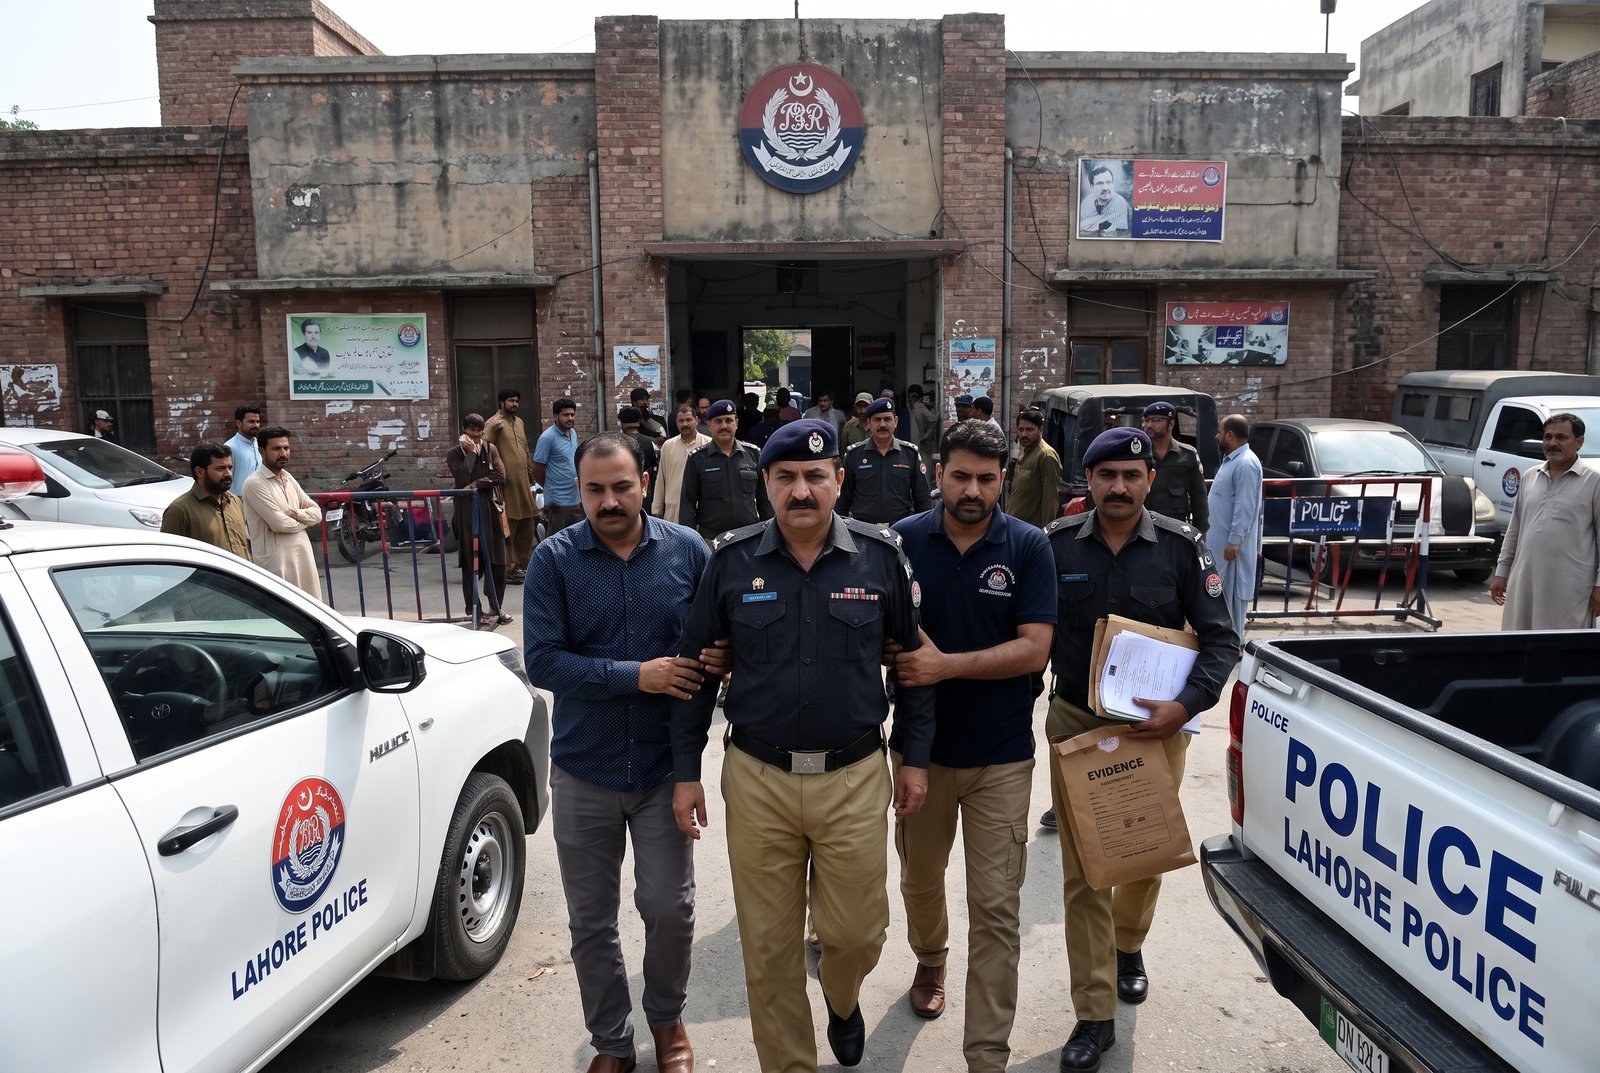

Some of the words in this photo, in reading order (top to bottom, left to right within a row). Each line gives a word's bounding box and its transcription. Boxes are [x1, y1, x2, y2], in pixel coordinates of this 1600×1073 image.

[1087, 757, 1145, 781] EVIDENCE
[1251, 699, 1289, 733] POLICE
[1285, 736, 1544, 964] POLICE
[231, 920, 308, 1001] LAHORE
[312, 878, 368, 941] POLICE
[1284, 816, 1392, 934] LAHORE
[1402, 900, 1546, 1048] POLICE
